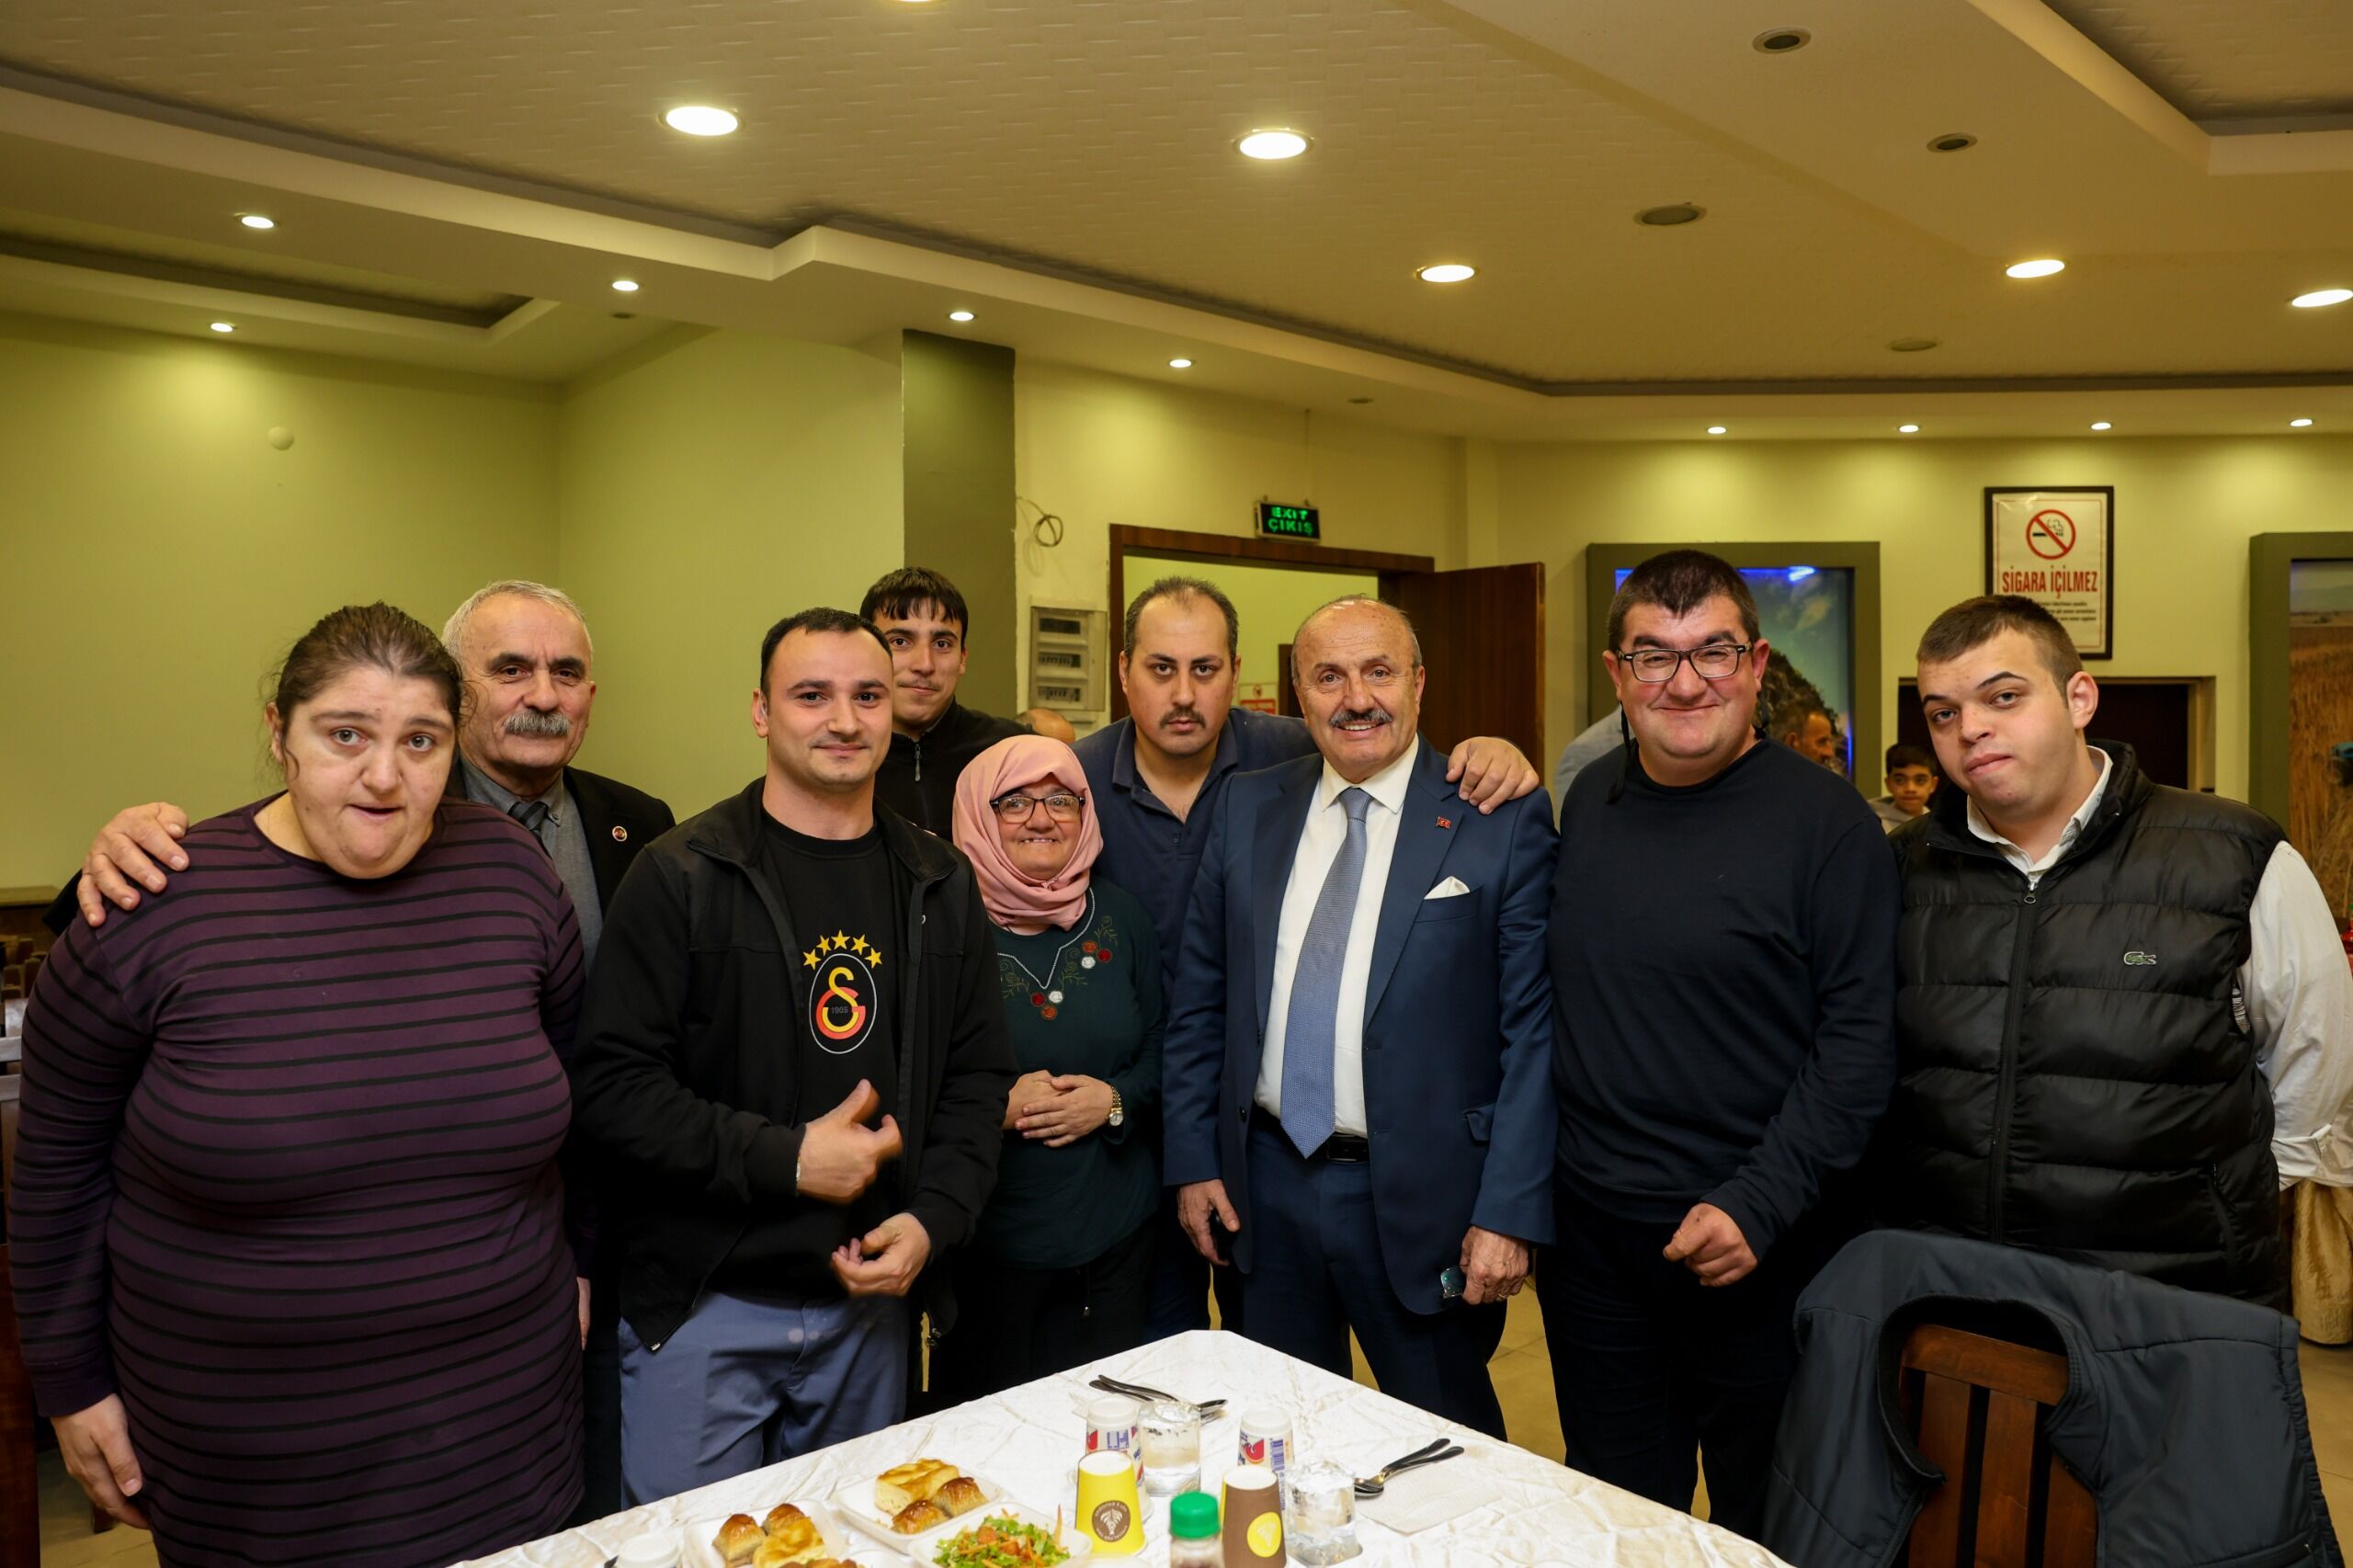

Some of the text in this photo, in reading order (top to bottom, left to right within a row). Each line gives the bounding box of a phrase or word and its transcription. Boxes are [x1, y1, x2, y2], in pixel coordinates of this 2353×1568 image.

[1271, 506, 1308, 520] EXIT
[2002, 564, 2097, 599] SİGARA İÇİLMEZ
